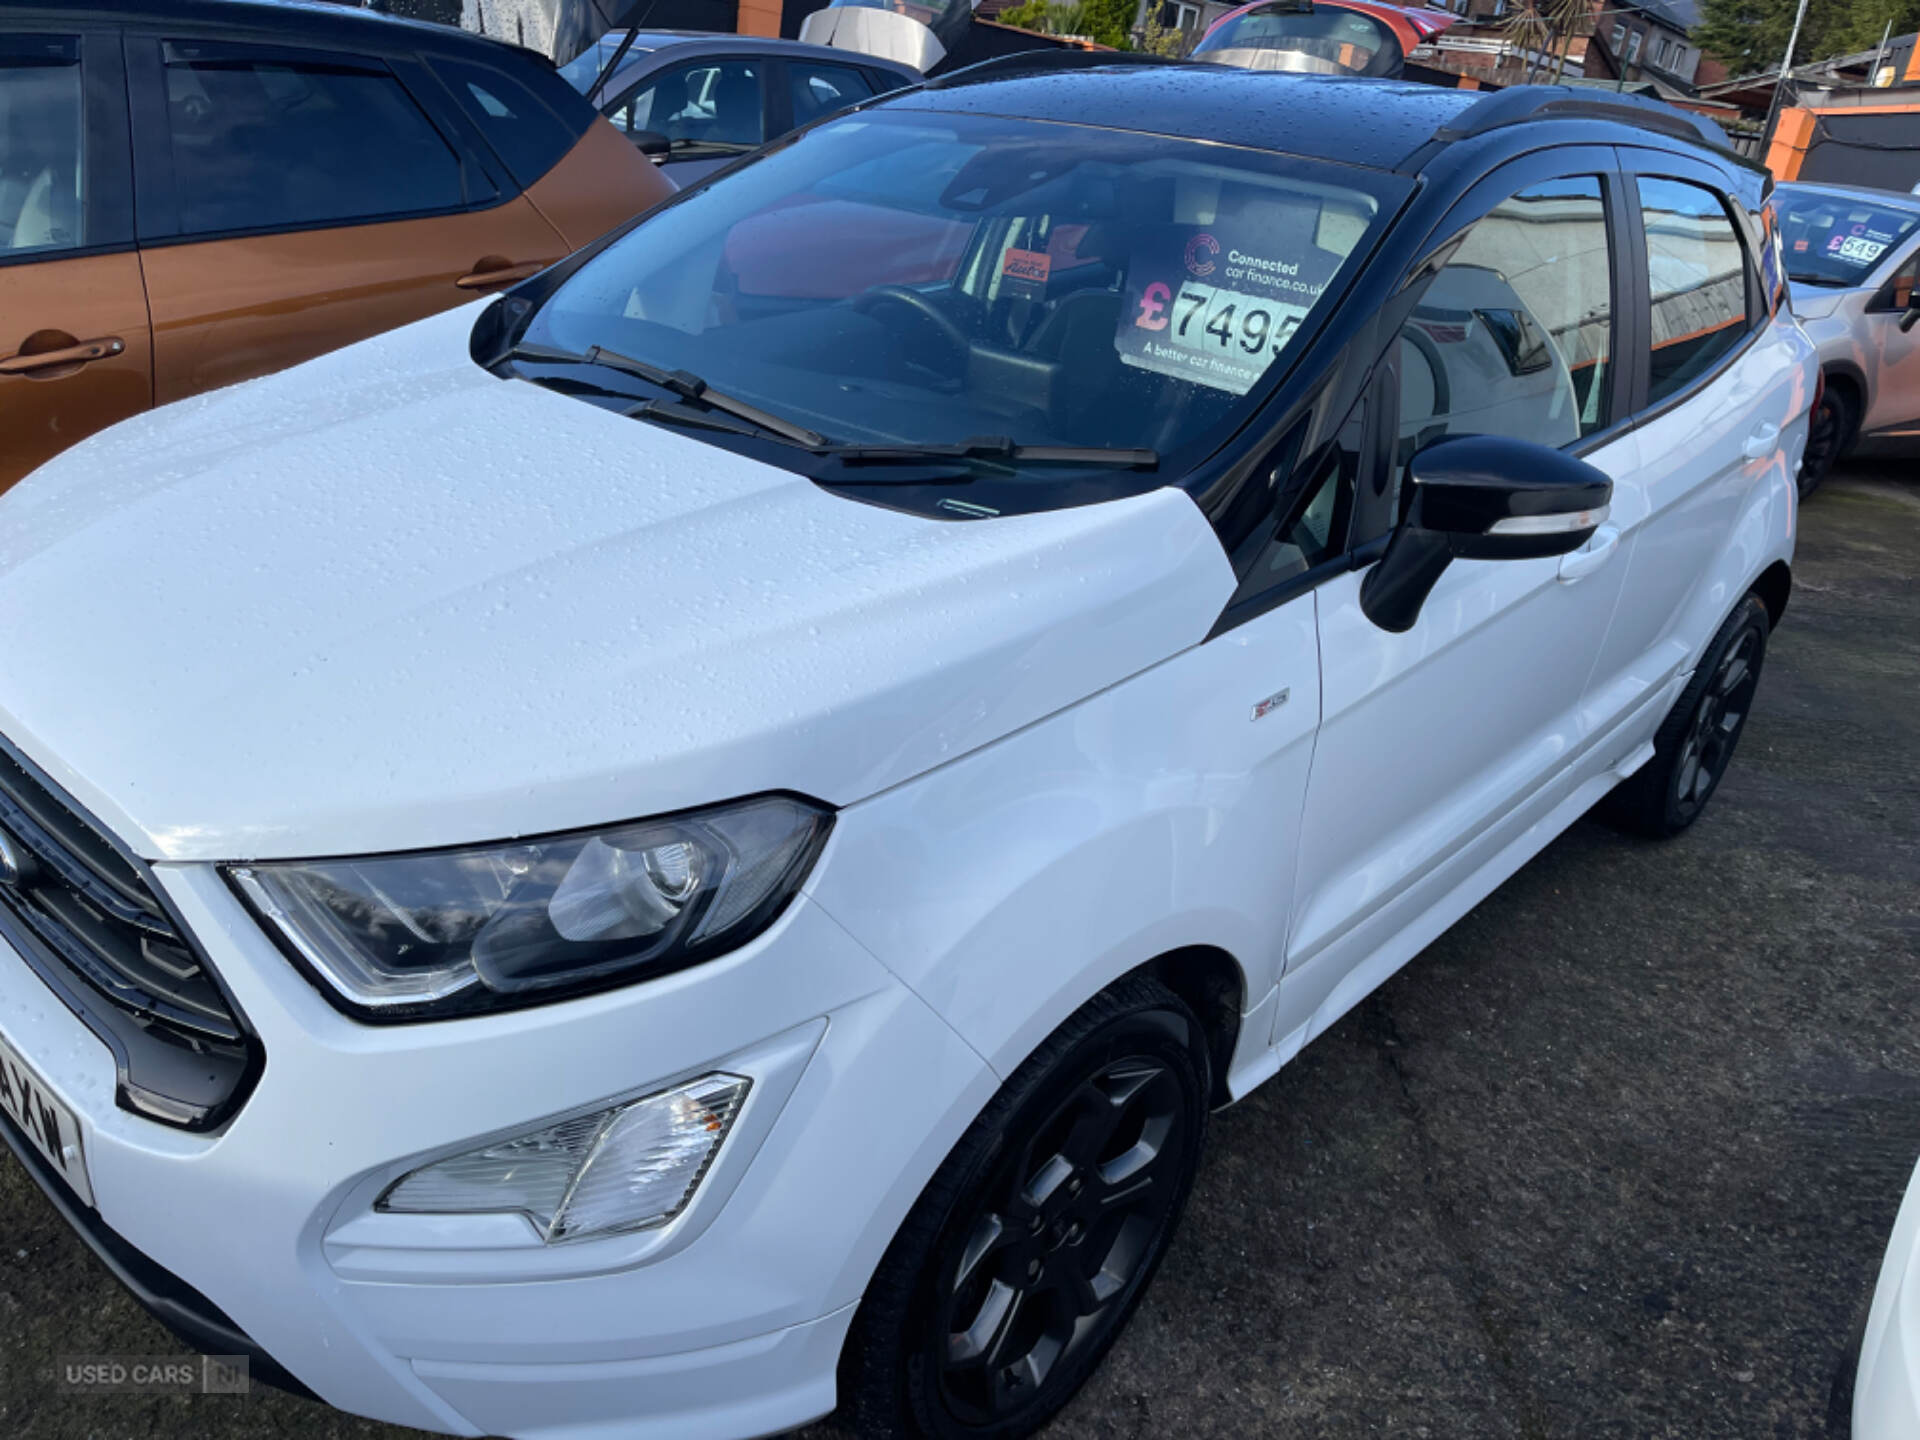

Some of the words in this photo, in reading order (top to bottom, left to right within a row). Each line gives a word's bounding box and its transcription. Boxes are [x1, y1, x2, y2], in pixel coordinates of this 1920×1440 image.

[1225, 267, 1245, 279] car
[1227, 249, 1299, 276] Connected
[1143, 341, 1152, 353] A
[1153, 344, 1188, 361] better
[1189, 356, 1209, 368] car
[1208, 357, 1252, 380] finance
